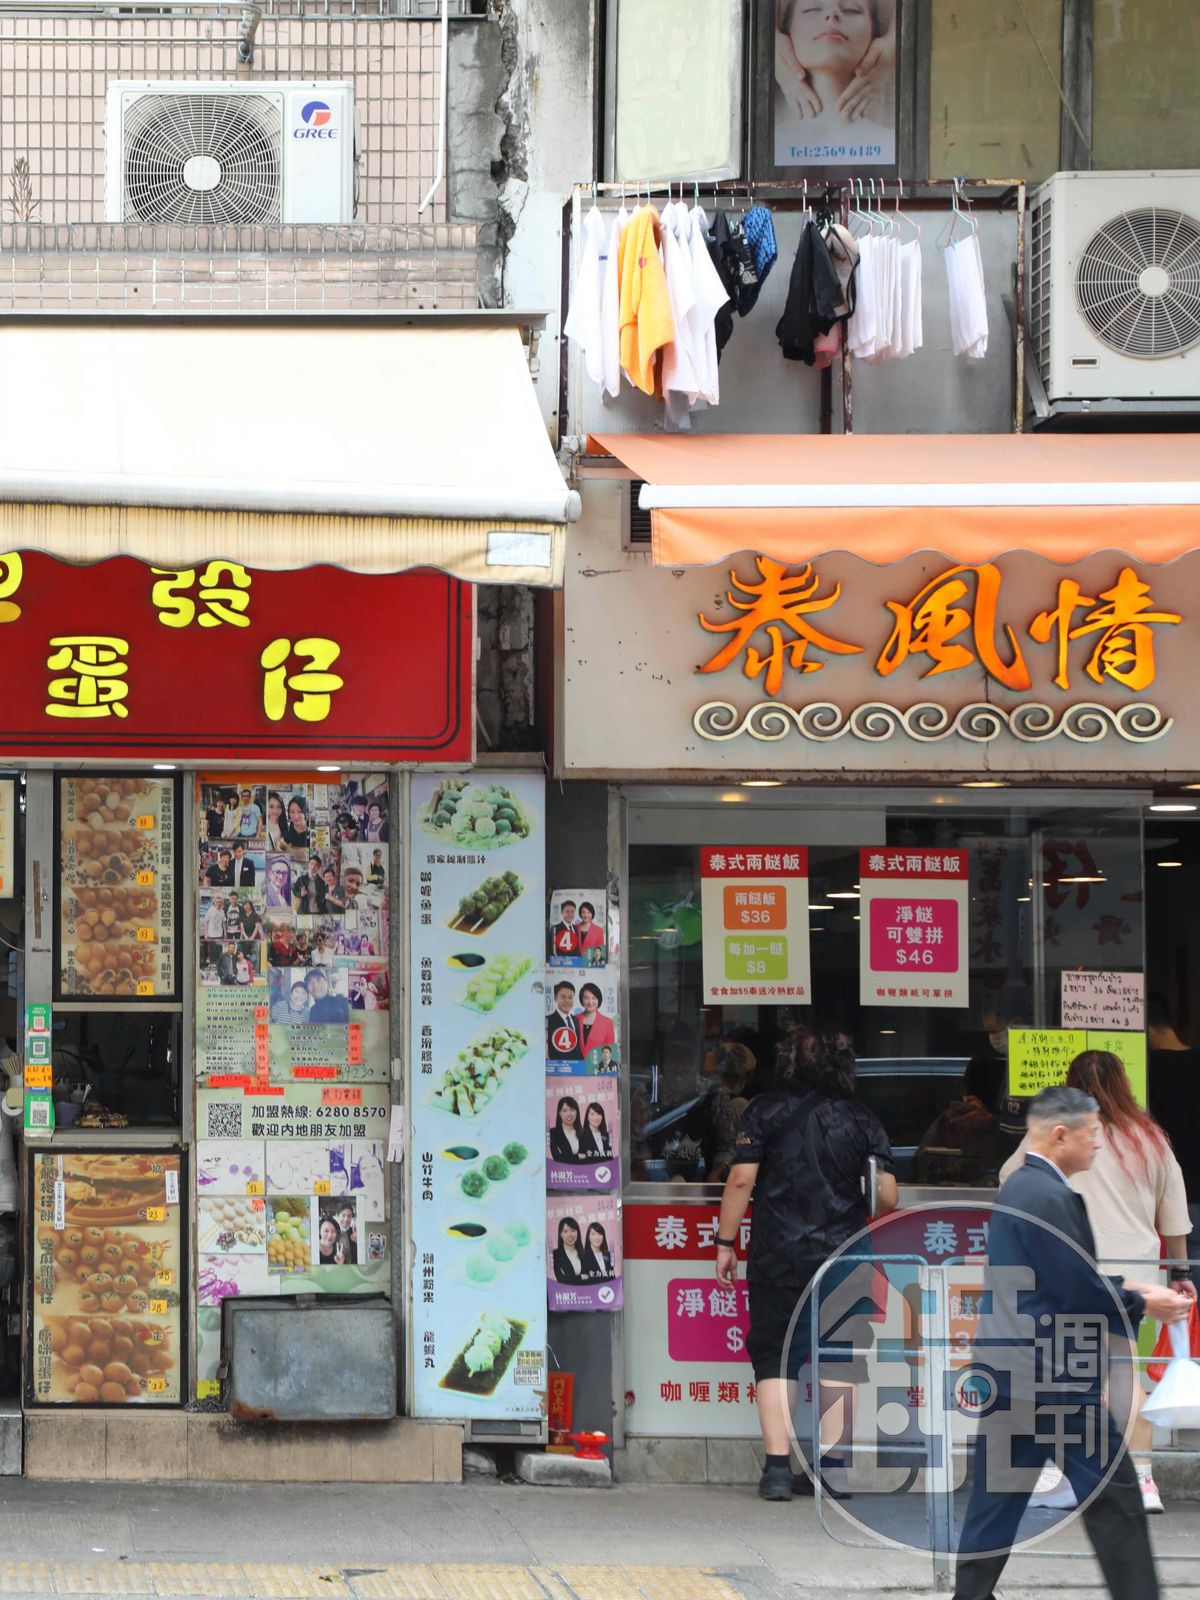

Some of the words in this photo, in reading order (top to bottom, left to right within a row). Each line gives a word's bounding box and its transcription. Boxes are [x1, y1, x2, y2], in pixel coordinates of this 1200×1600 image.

[293, 128, 338, 139] GREE
[789, 144, 845, 158] Tel:2569
[849, 144, 882, 158] 6189
[696, 556, 1183, 698] 泰風情
[709, 853, 801, 872] 泰式兩餸飯
[868, 854, 961, 873] 泰式兩餸飯
[734, 892, 776, 907] 兩餸飯
[740, 910, 771, 925] $36
[895, 905, 934, 923] 淨餸
[559, 931, 573, 951] 4
[885, 926, 944, 945] 可雙拼
[895, 949, 934, 965] $46
[745, 960, 767, 975] $8
[558, 1029, 572, 1049] 4
[316, 1106, 350, 1118] 6280
[353, 1106, 387, 1118] 8570
[251, 1123, 367, 1138] 歡迎內地朋友加盟
[421, 1151, 434, 1201] 山竹牛肉
[676, 1287, 750, 1319] 淨餸
